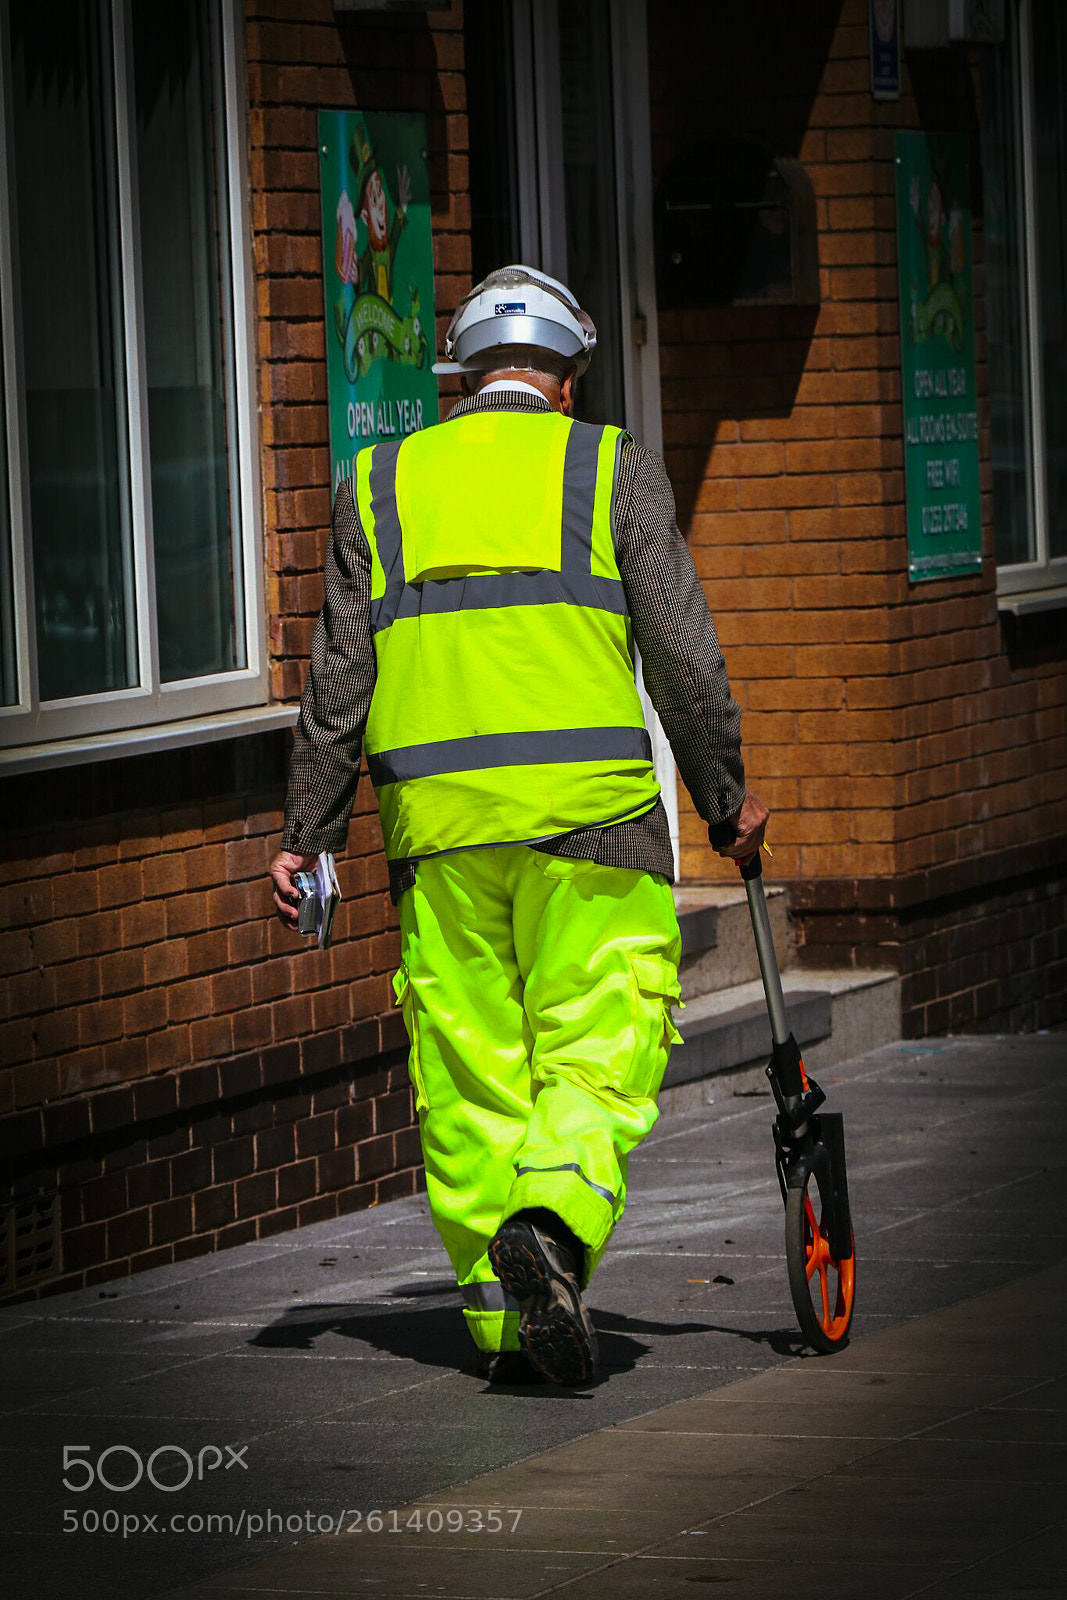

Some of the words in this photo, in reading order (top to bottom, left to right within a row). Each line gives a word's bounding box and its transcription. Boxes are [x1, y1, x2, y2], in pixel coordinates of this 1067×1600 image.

[356, 303, 395, 338] WELCOME
[914, 369, 933, 398] OPEN
[935, 369, 947, 396] ALL
[948, 368, 966, 396] YEAR
[347, 400, 374, 437] OPEN
[376, 401, 395, 434] ALL
[397, 398, 423, 433] YEAR
[926, 460, 943, 488] FREE
